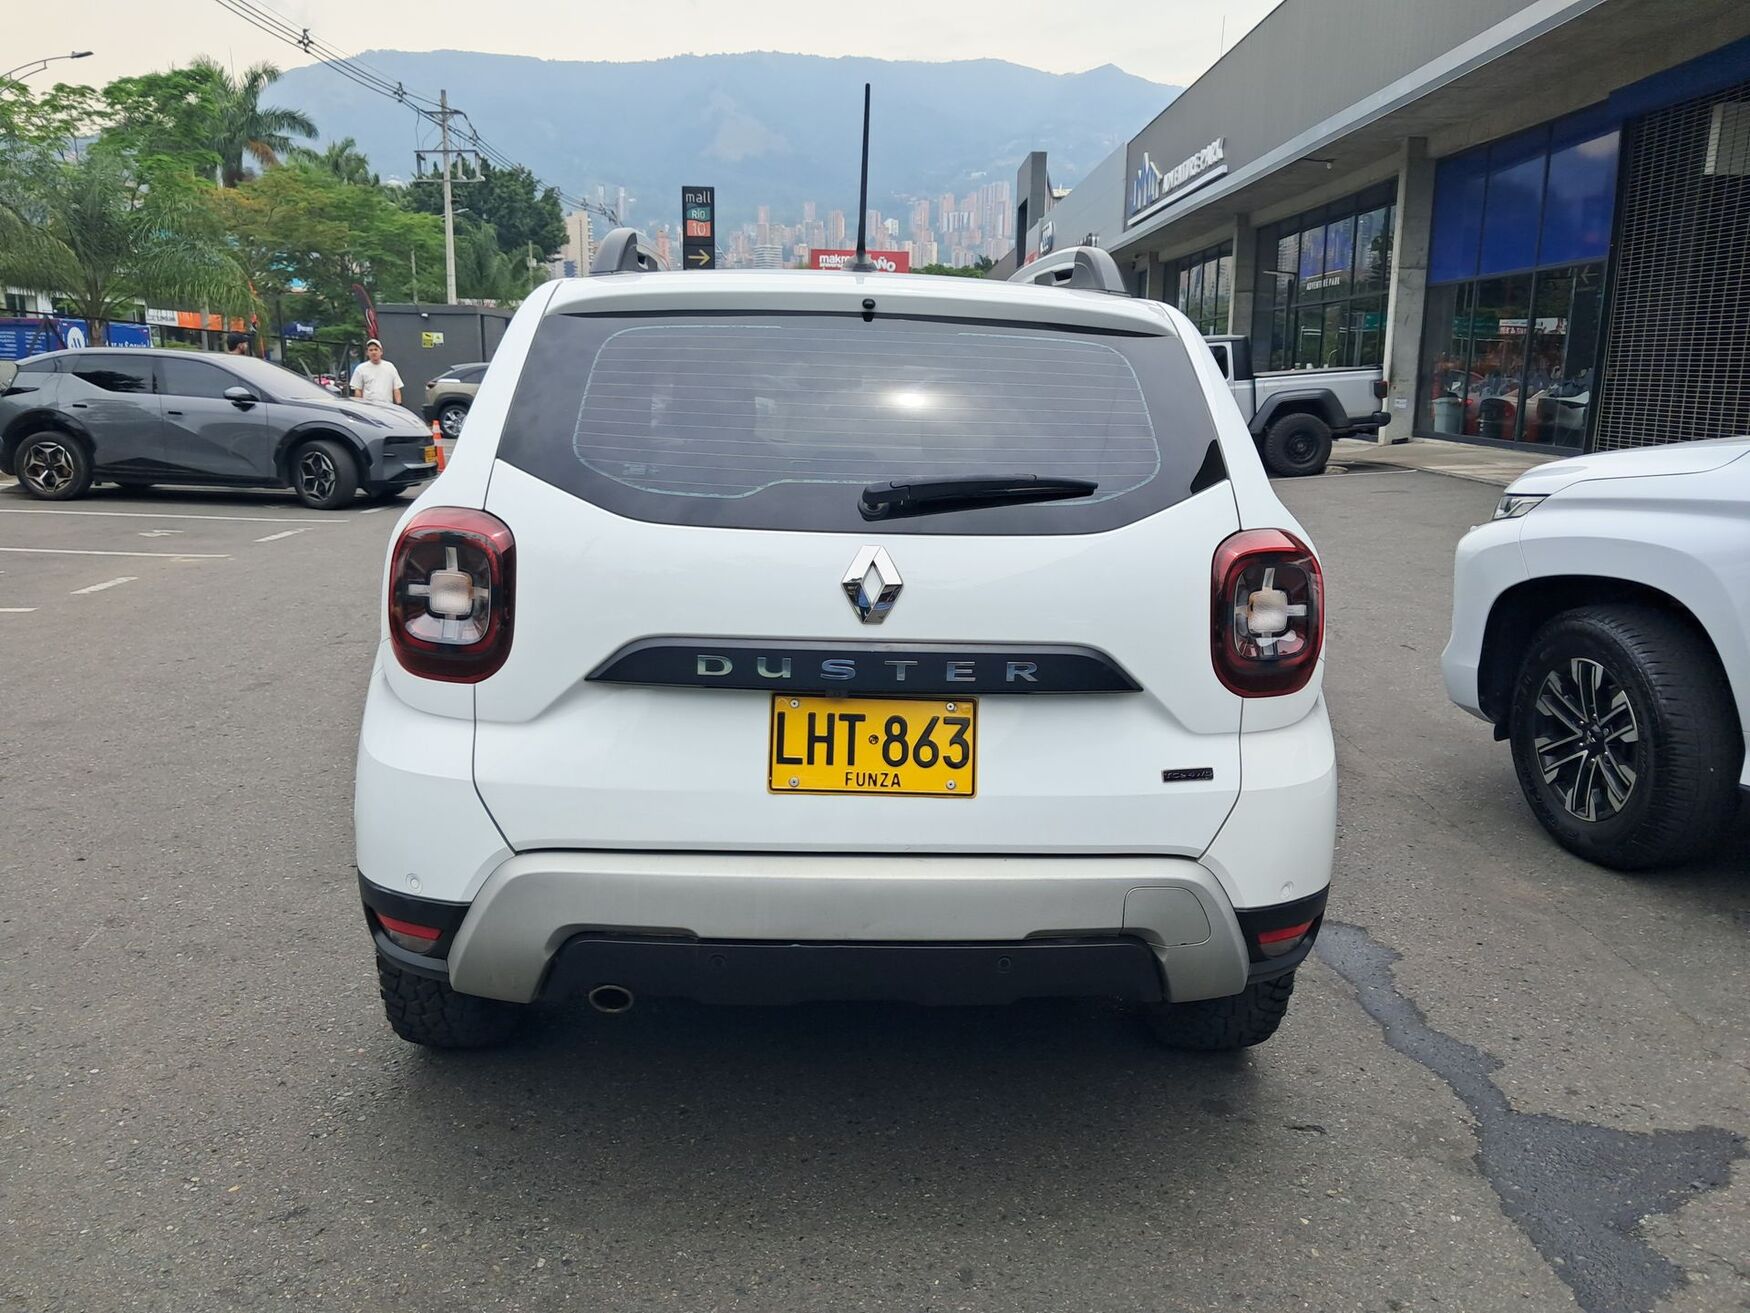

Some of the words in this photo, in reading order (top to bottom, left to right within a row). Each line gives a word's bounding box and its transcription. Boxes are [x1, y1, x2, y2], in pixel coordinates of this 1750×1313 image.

[685, 190, 711, 204] mall
[692, 223, 706, 235] 10
[819, 253, 851, 265] makr
[697, 654, 1039, 682] DUSTER
[776, 711, 866, 766] LHT
[882, 715, 970, 769] 863
[845, 771, 901, 787] FUNZA
